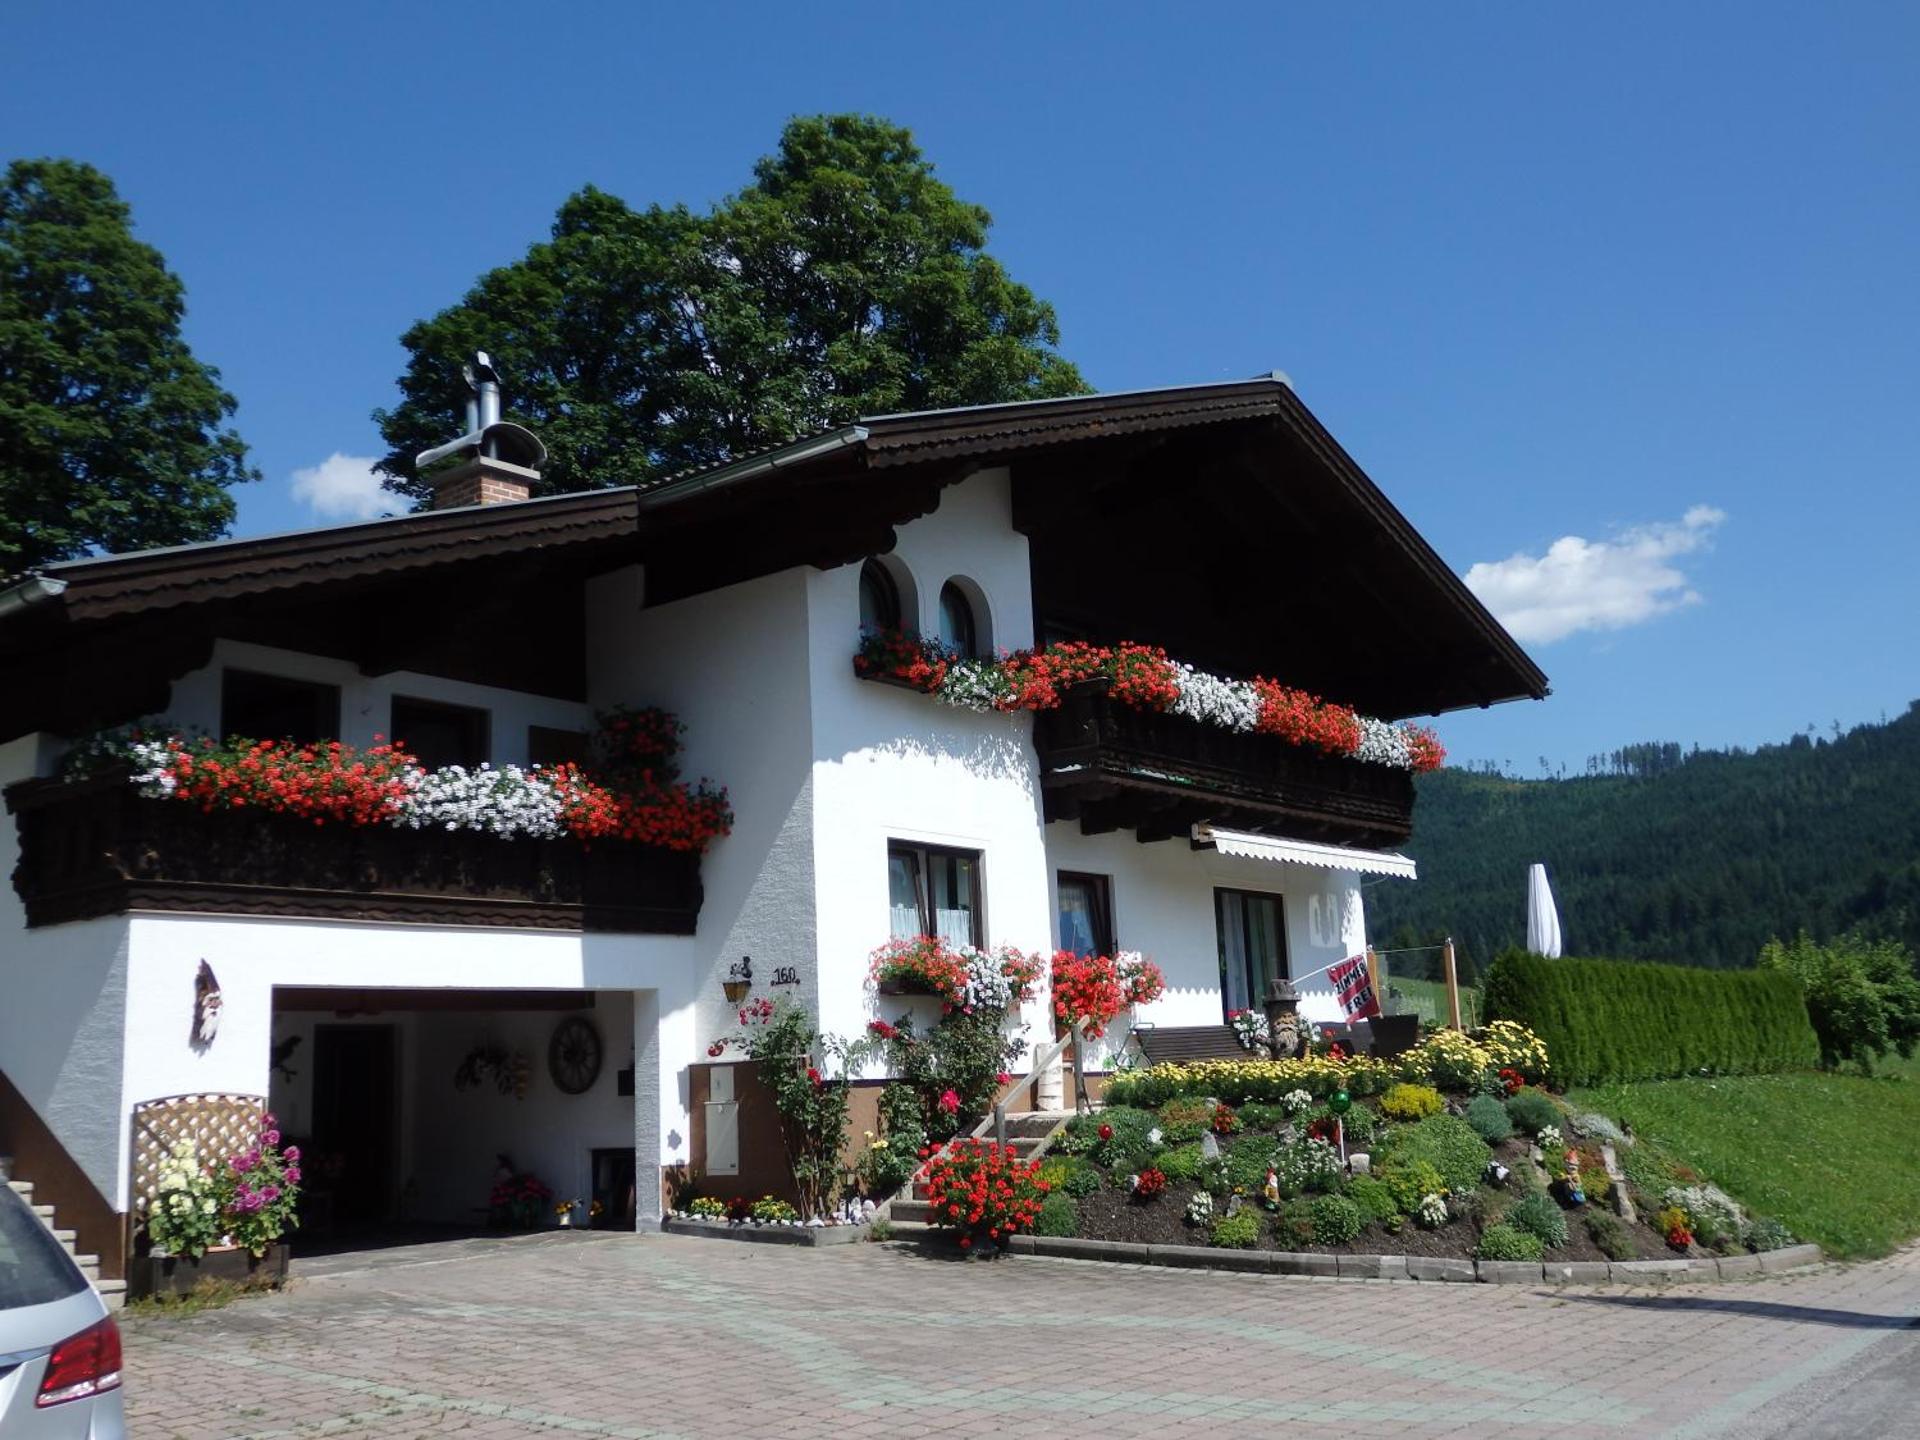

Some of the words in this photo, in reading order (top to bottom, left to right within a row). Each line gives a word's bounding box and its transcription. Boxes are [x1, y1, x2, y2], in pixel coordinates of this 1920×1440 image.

[773, 967, 796, 984] 160
[1335, 962, 1367, 994] ZIMMER
[1346, 986, 1373, 1014] FREI
